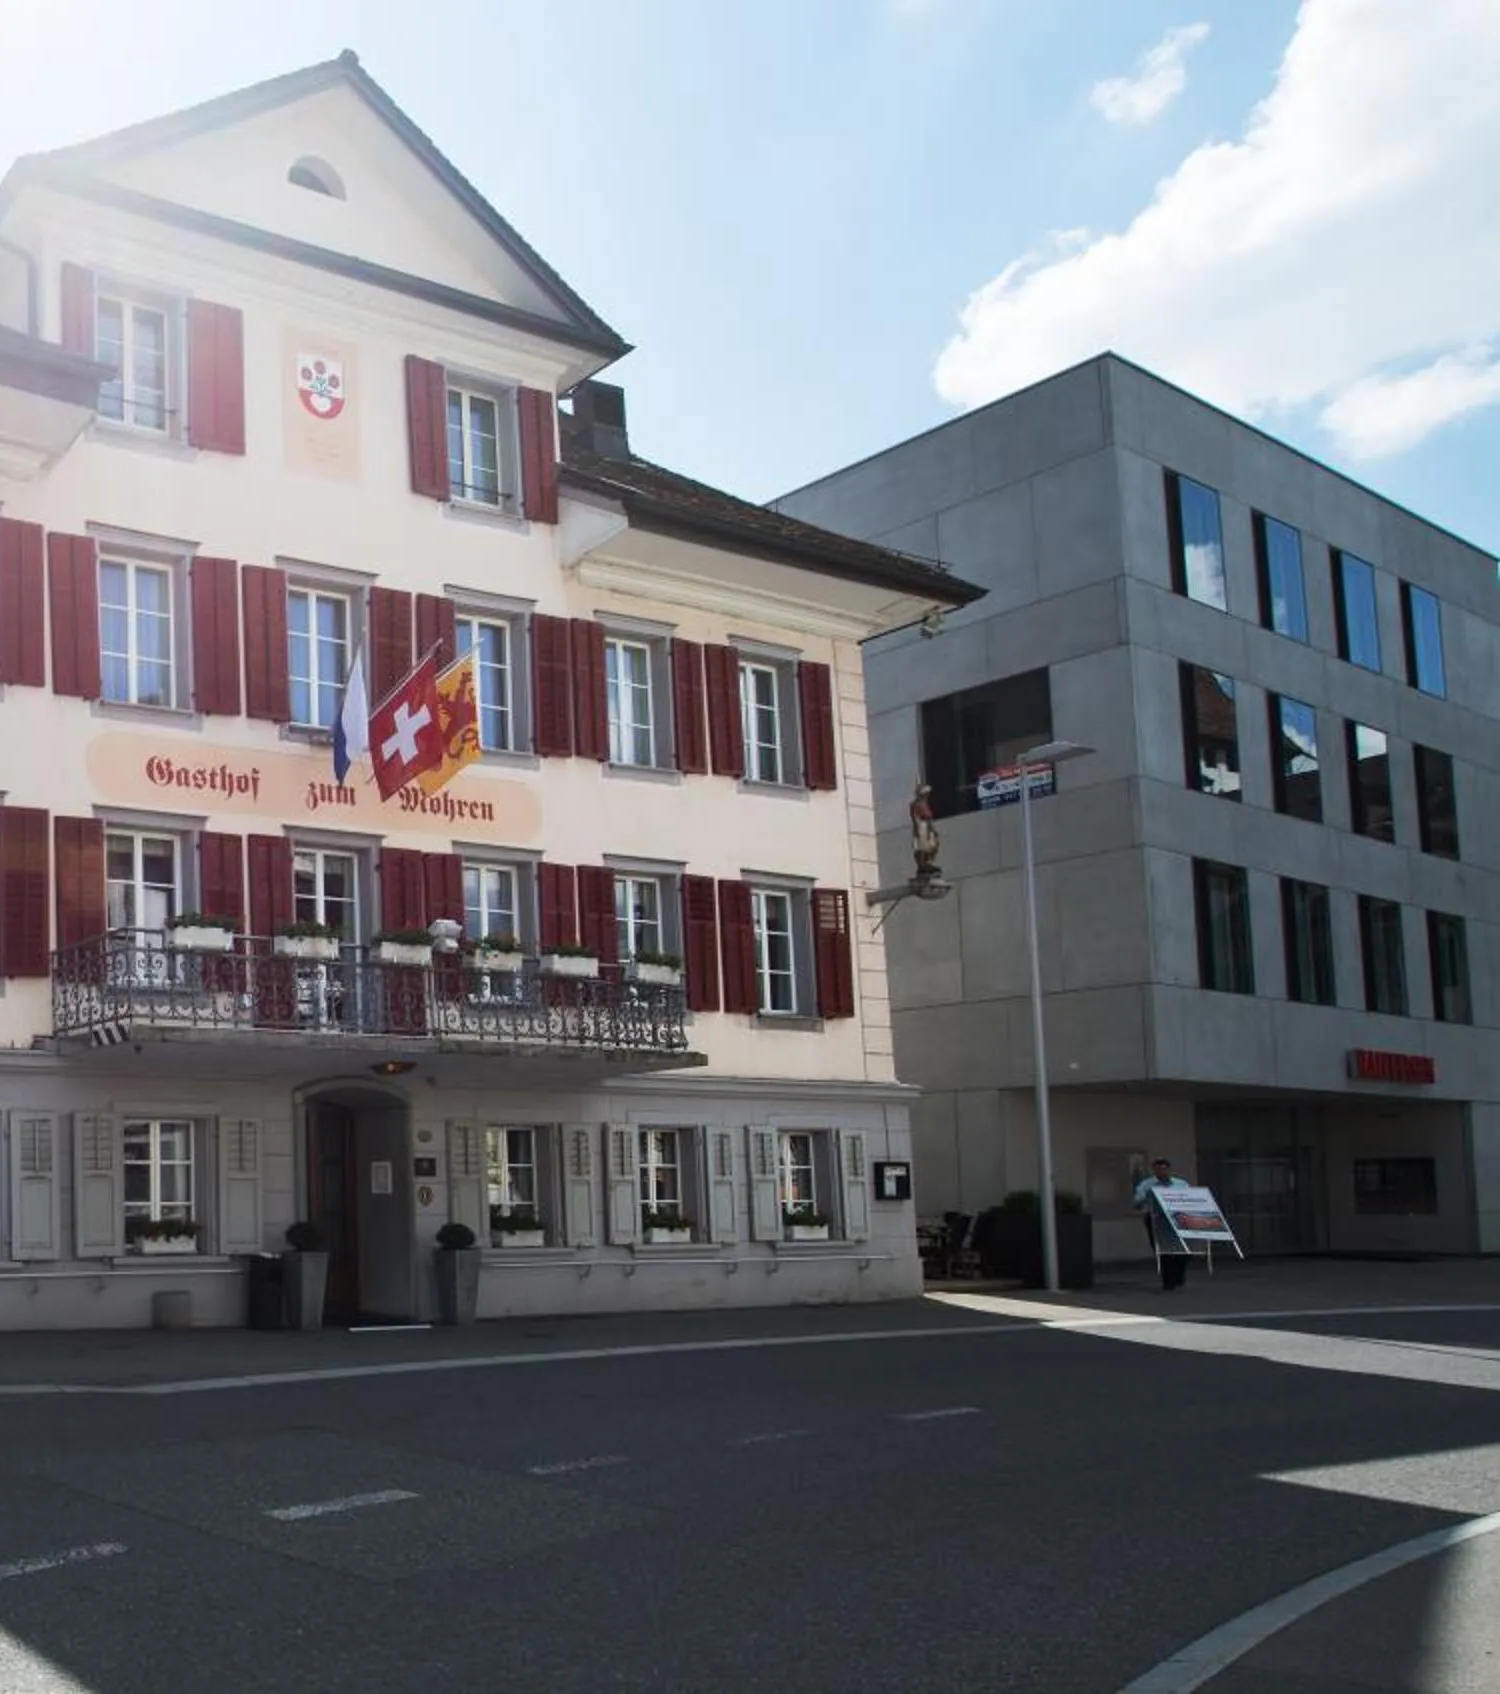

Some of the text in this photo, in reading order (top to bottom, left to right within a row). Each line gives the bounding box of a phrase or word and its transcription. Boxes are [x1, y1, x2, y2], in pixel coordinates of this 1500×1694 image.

[146, 755, 494, 822] Gasthof zum Mohren
